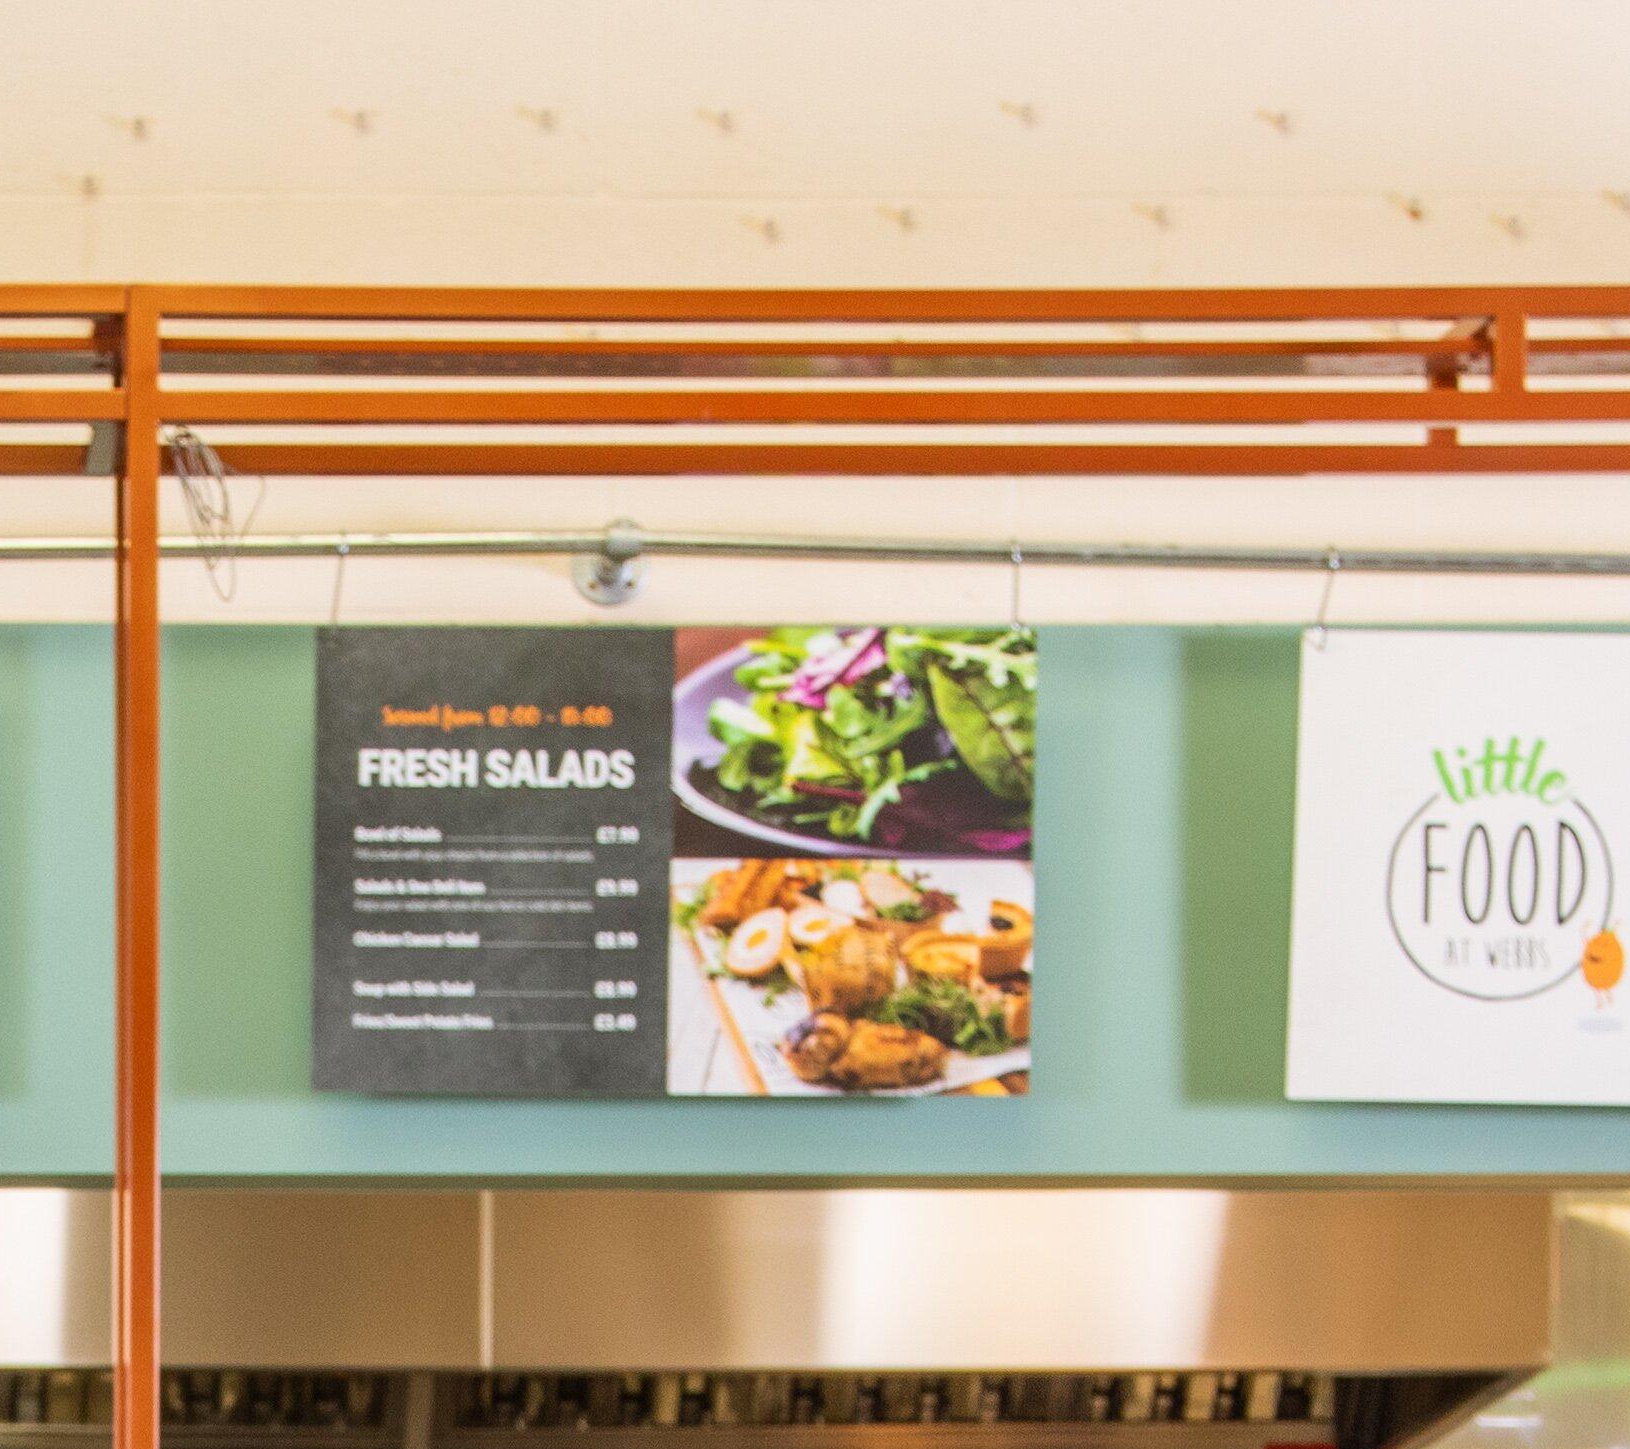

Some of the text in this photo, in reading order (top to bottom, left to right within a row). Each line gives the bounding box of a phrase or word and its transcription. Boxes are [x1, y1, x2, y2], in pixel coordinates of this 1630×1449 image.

[357, 748, 636, 789] FRESH SALADS
[1432, 735, 1567, 805] little
[1424, 819, 1588, 926] FOOD
